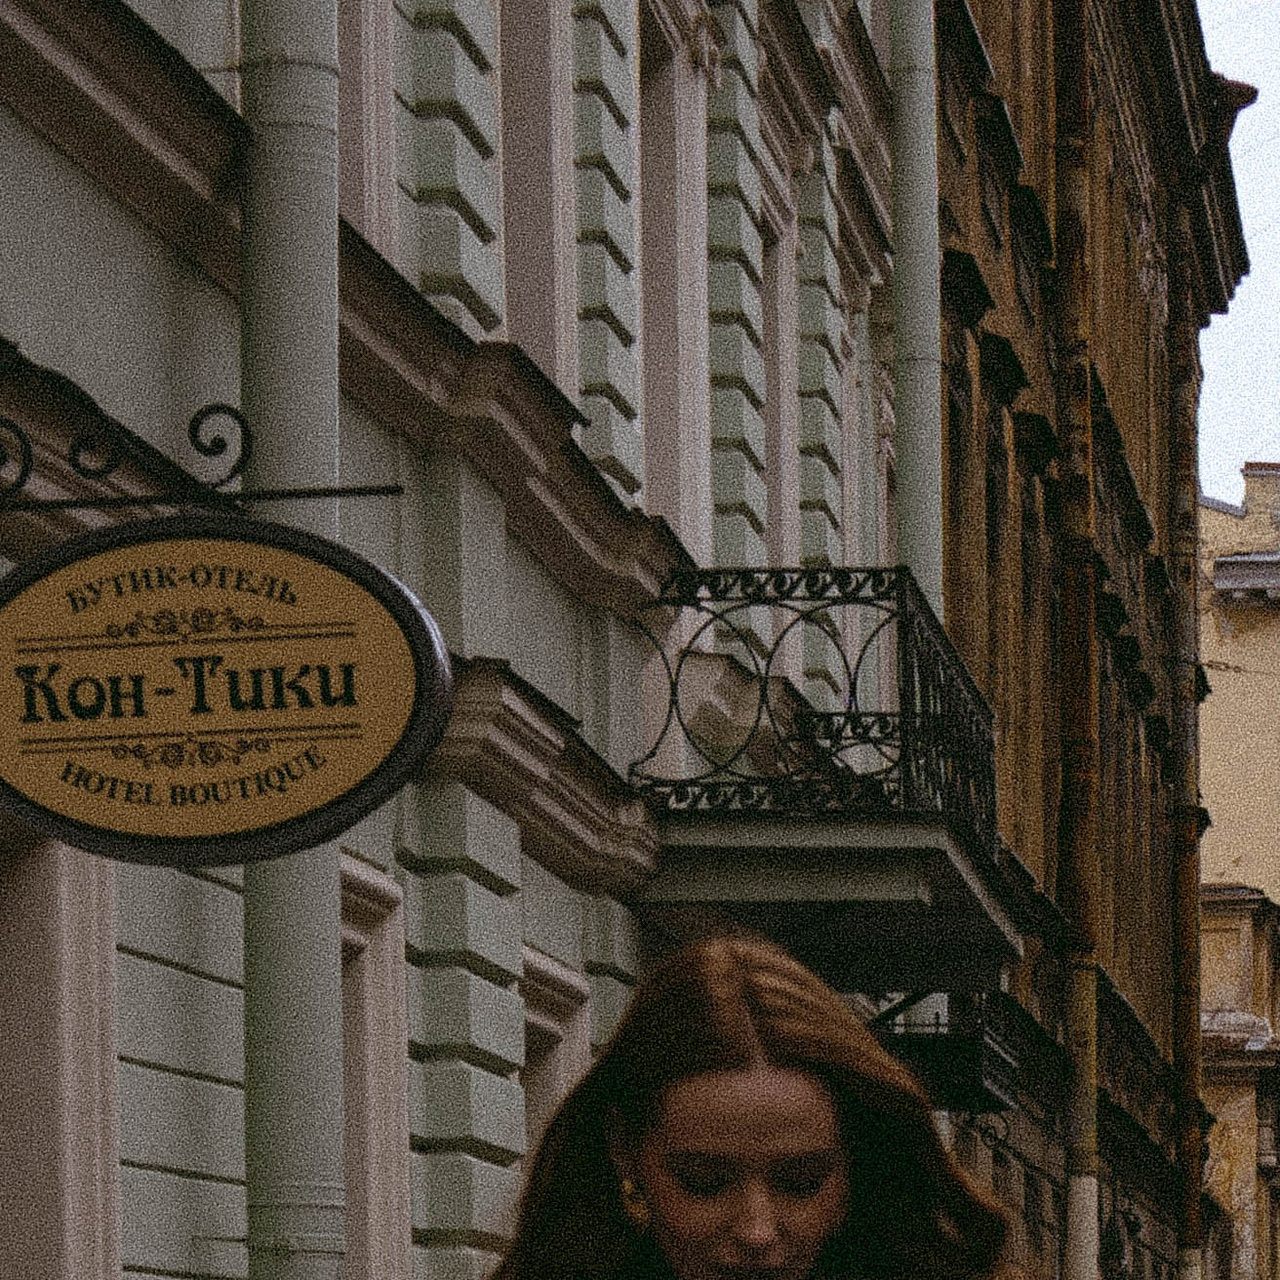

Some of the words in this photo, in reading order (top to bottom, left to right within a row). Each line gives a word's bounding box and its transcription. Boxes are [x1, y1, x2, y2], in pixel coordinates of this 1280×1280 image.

[65, 563, 298, 614] БУТИК-ОТЕЛЬ
[59, 761, 163, 807] HOTEL
[169, 745, 328, 807] BOUTIQUE
